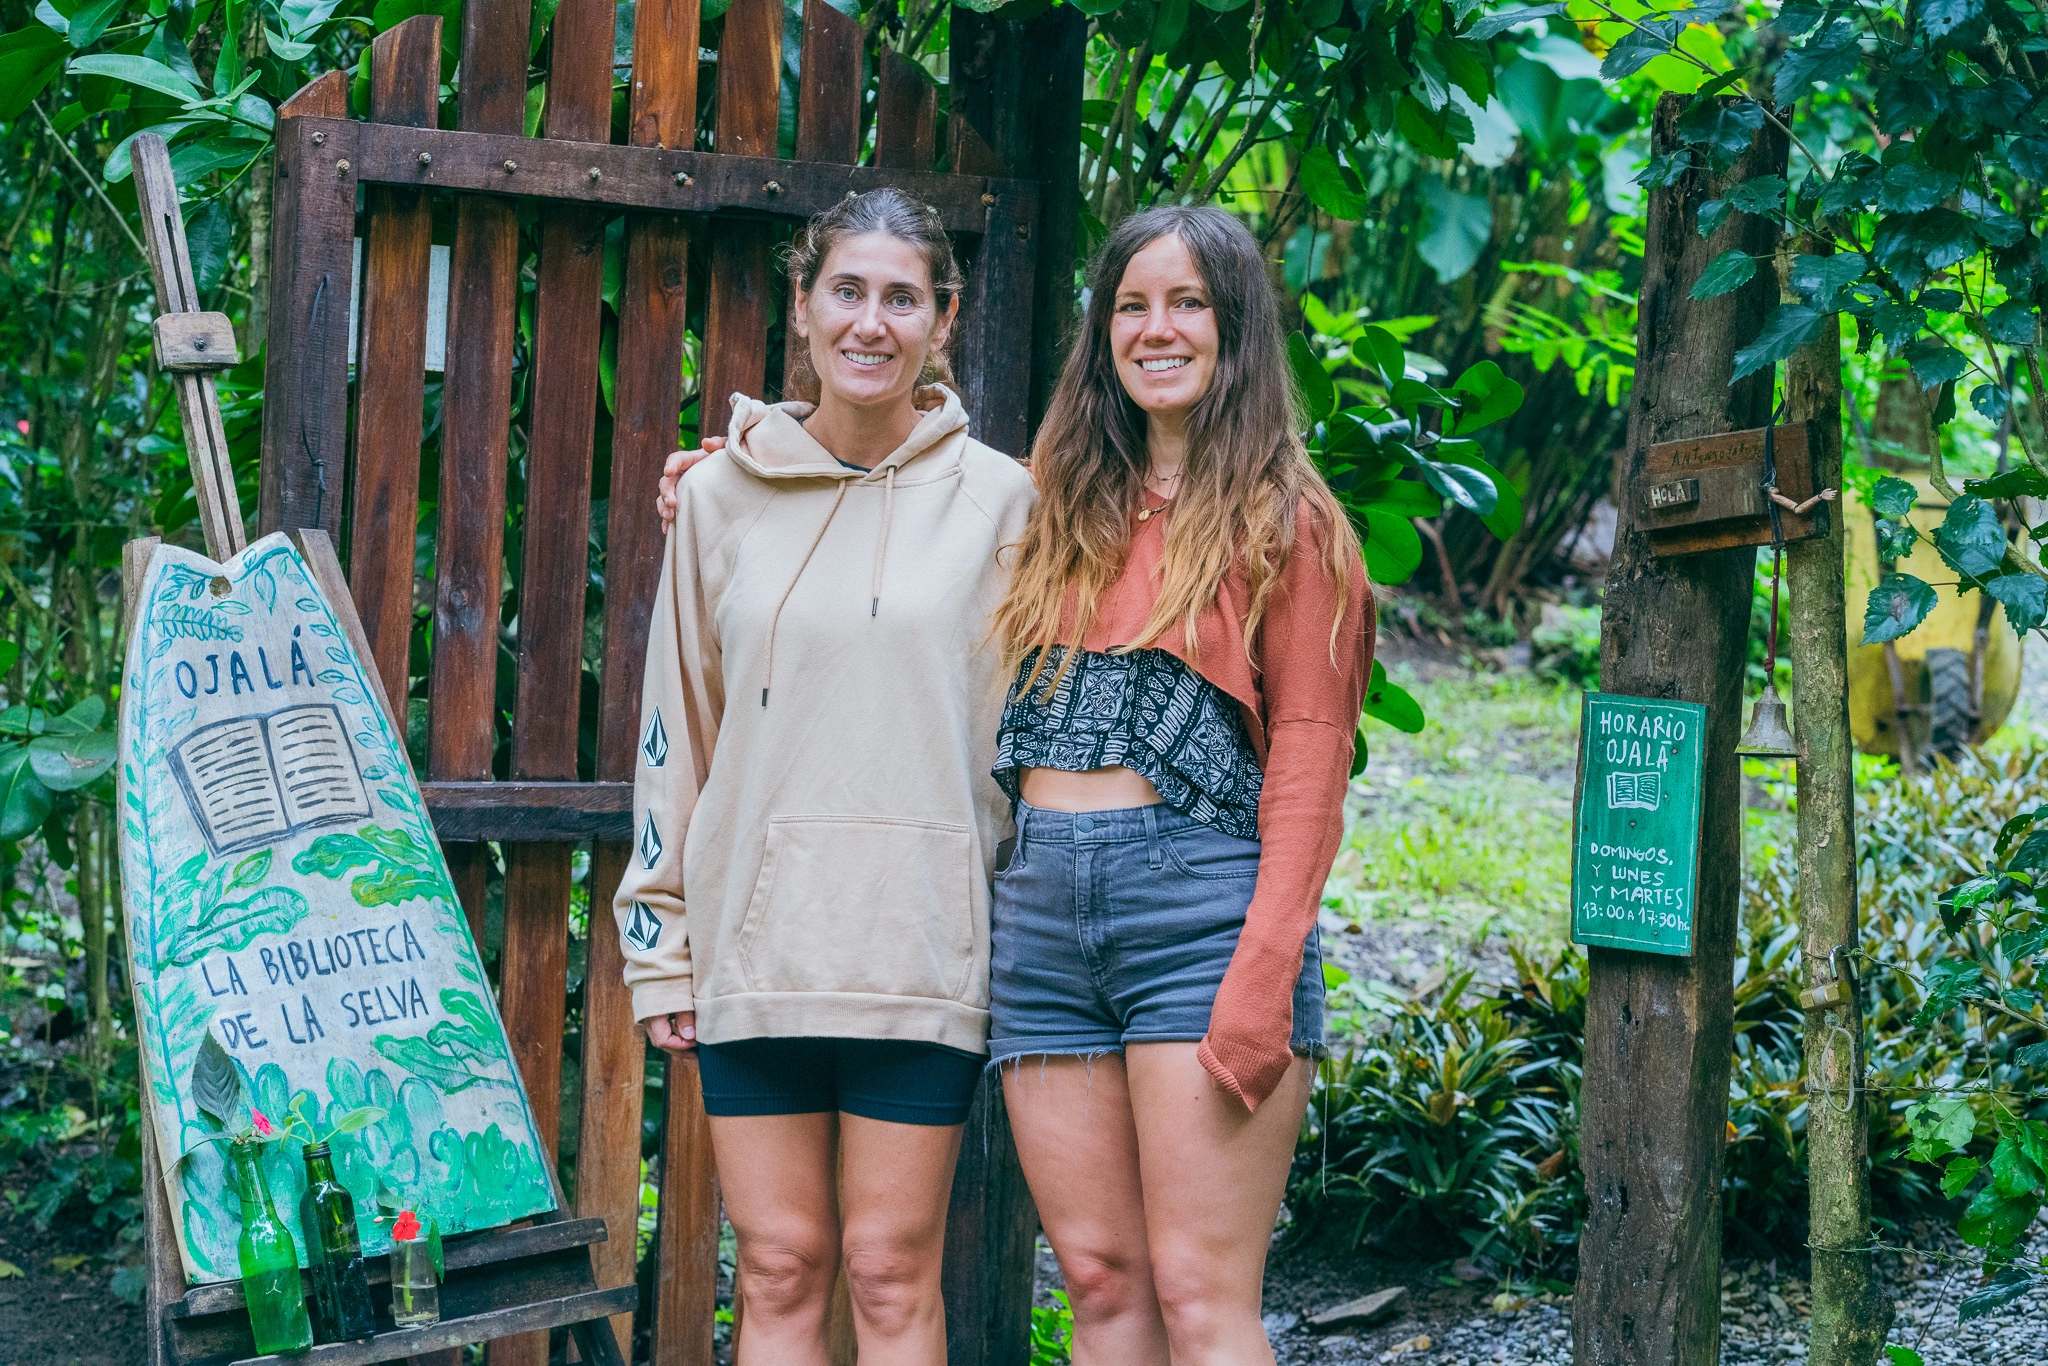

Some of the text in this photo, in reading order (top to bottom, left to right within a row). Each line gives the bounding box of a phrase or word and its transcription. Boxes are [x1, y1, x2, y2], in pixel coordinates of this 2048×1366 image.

[1651, 482, 1687, 507] HOLA
[174, 624, 315, 699] OJALÁ
[1600, 710, 1686, 741] HORARIO
[1591, 864, 1665, 887] Y LUNES
[1590, 885, 1684, 910] Y MARTES
[1627, 910, 1635, 921] A
[201, 919, 426, 997] LA BIBLIOTECA
[219, 976, 430, 1050] DE LA SELVA
